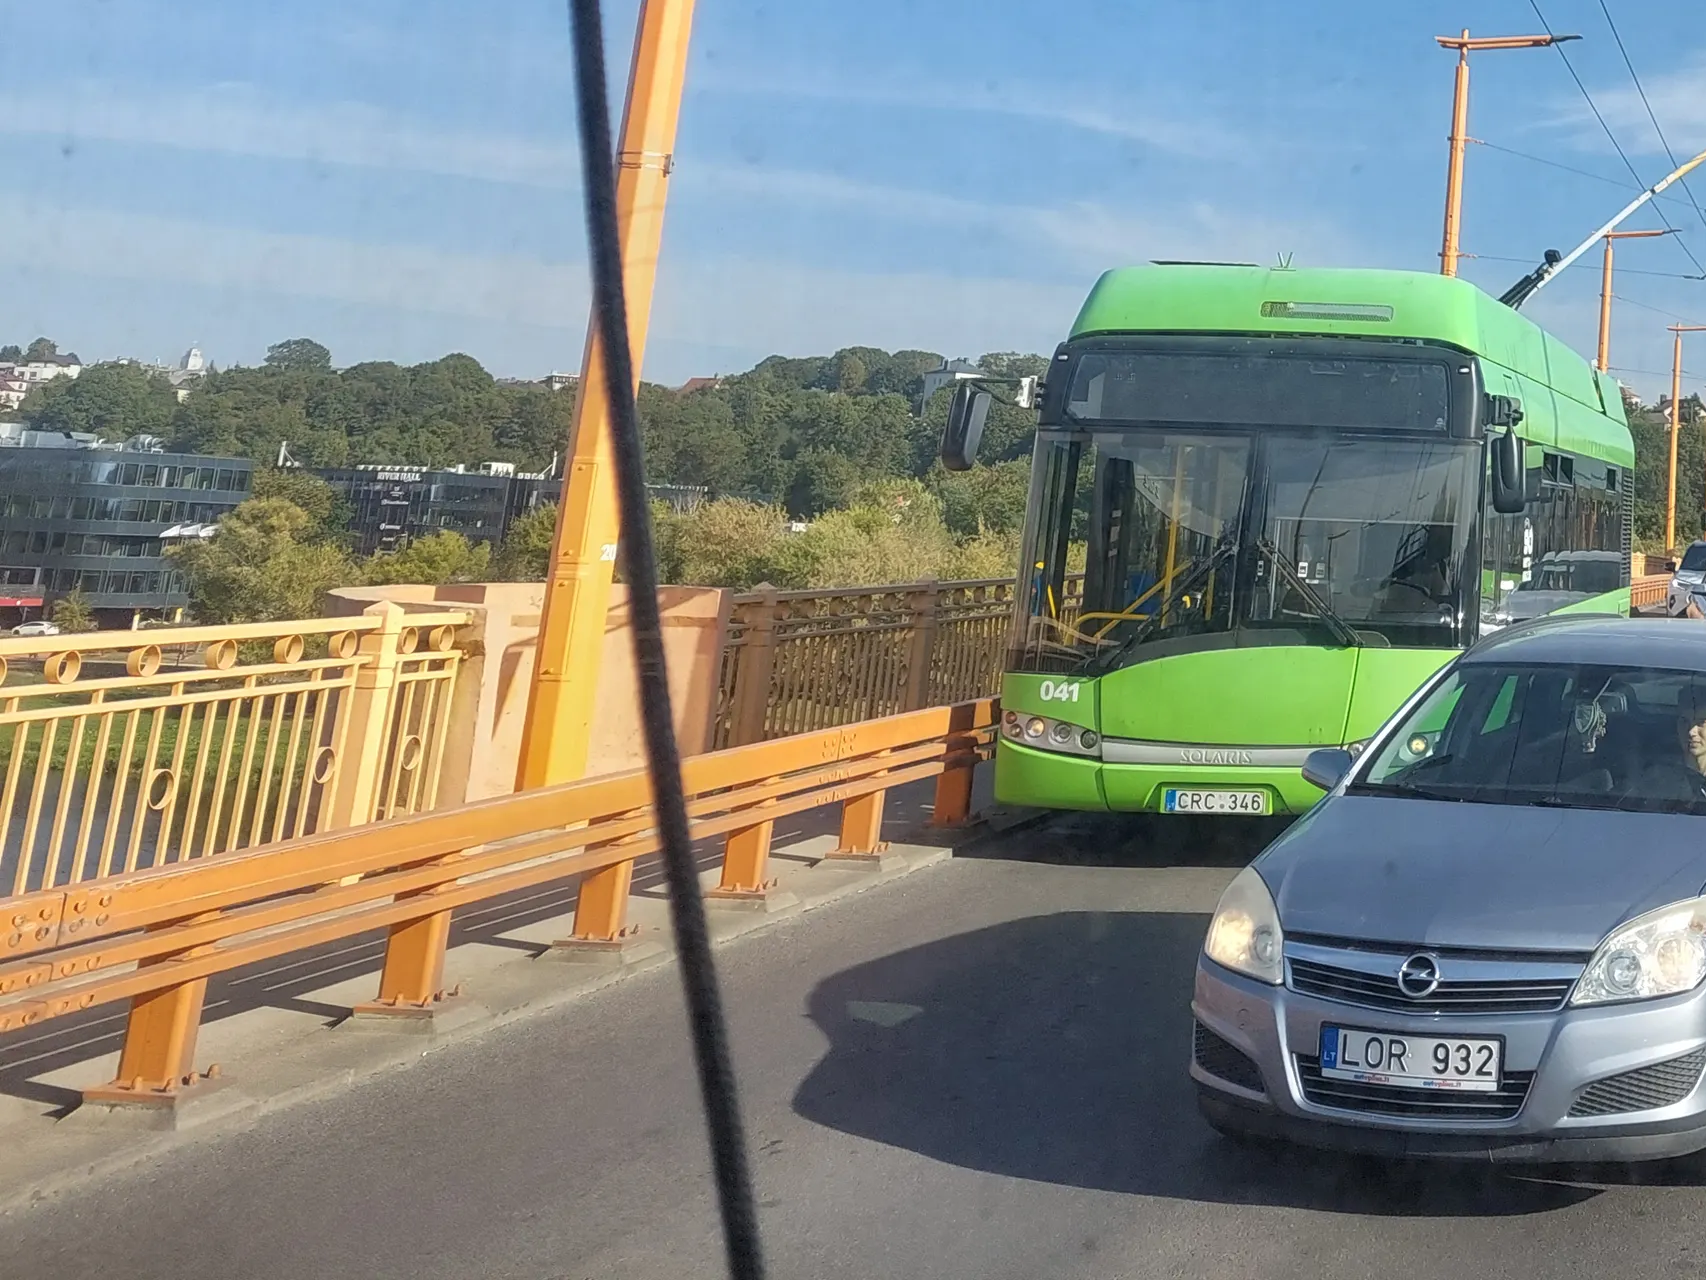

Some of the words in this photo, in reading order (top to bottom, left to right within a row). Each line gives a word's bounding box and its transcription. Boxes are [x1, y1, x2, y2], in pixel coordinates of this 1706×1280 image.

[1040, 680, 1080, 702] 041
[1180, 749, 1252, 765] SOLARIS
[1178, 793, 1215, 810] CRC
[1228, 793, 1261, 811] 346
[1323, 1051, 1336, 1062] LT
[1341, 1033, 1408, 1072] LOR
[1432, 1042, 1494, 1076] 932
